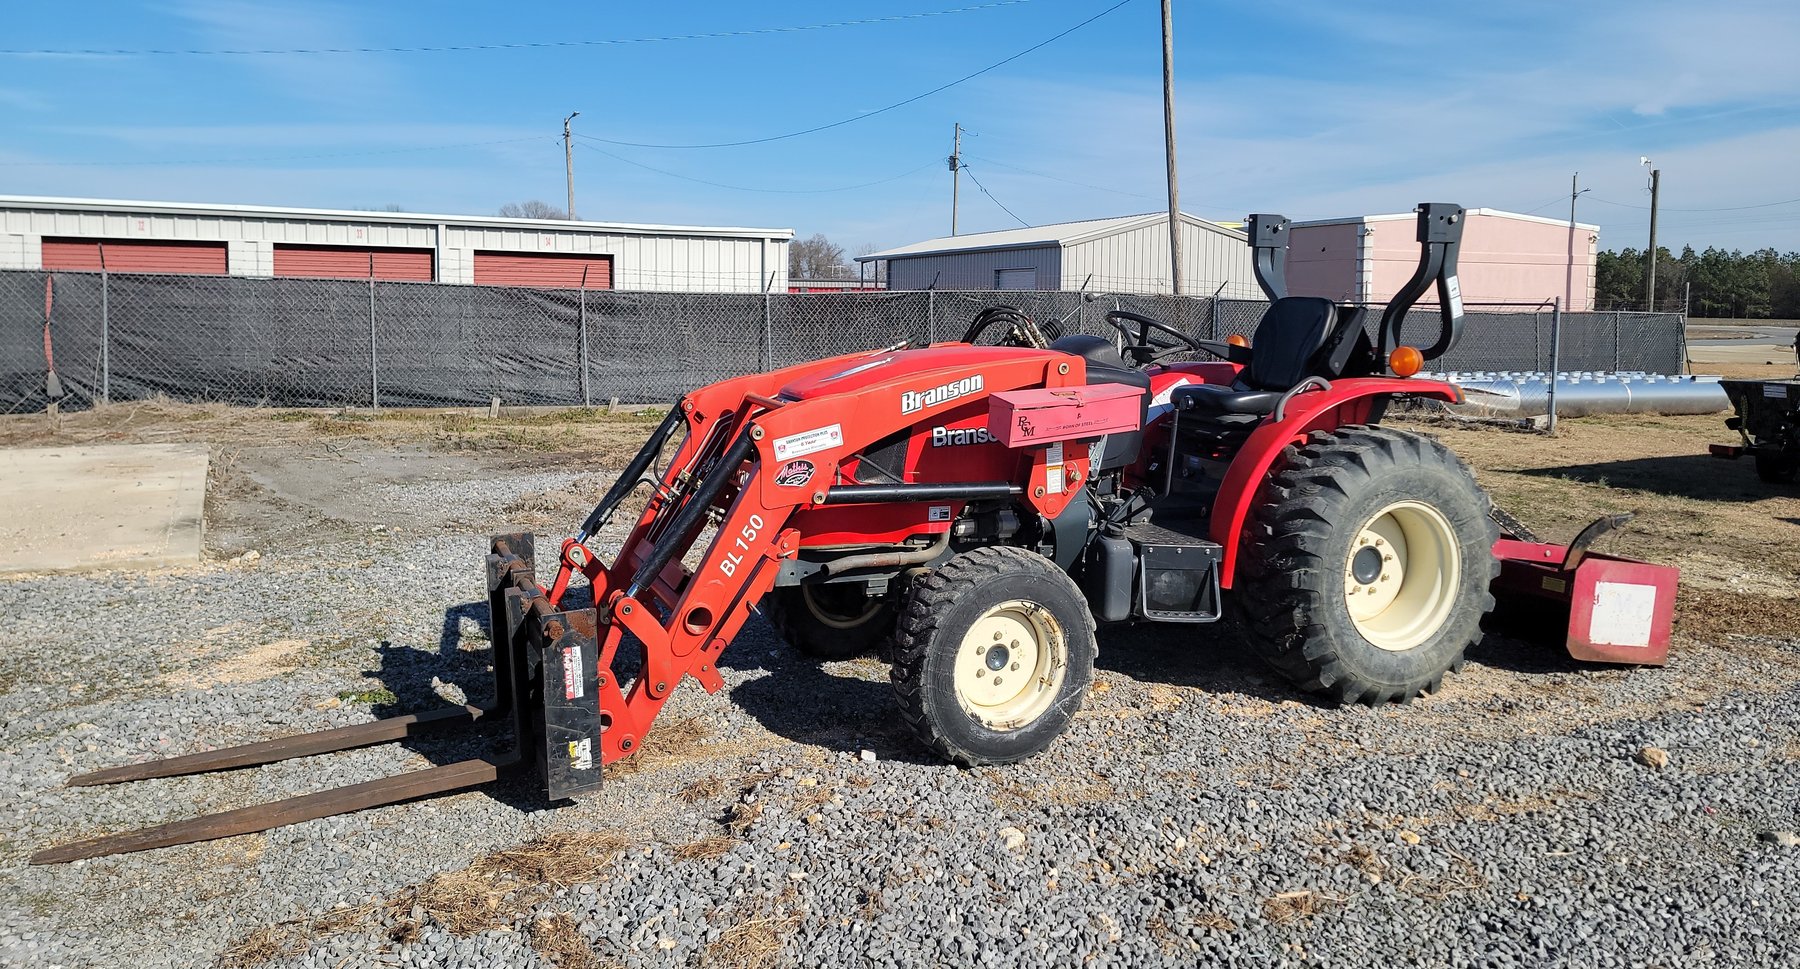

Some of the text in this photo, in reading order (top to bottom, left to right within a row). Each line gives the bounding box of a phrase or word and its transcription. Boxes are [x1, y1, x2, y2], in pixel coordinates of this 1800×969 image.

[901, 374, 984, 416] Branson
[932, 426, 997, 447] Brans
[720, 514, 764, 578] BL 150
